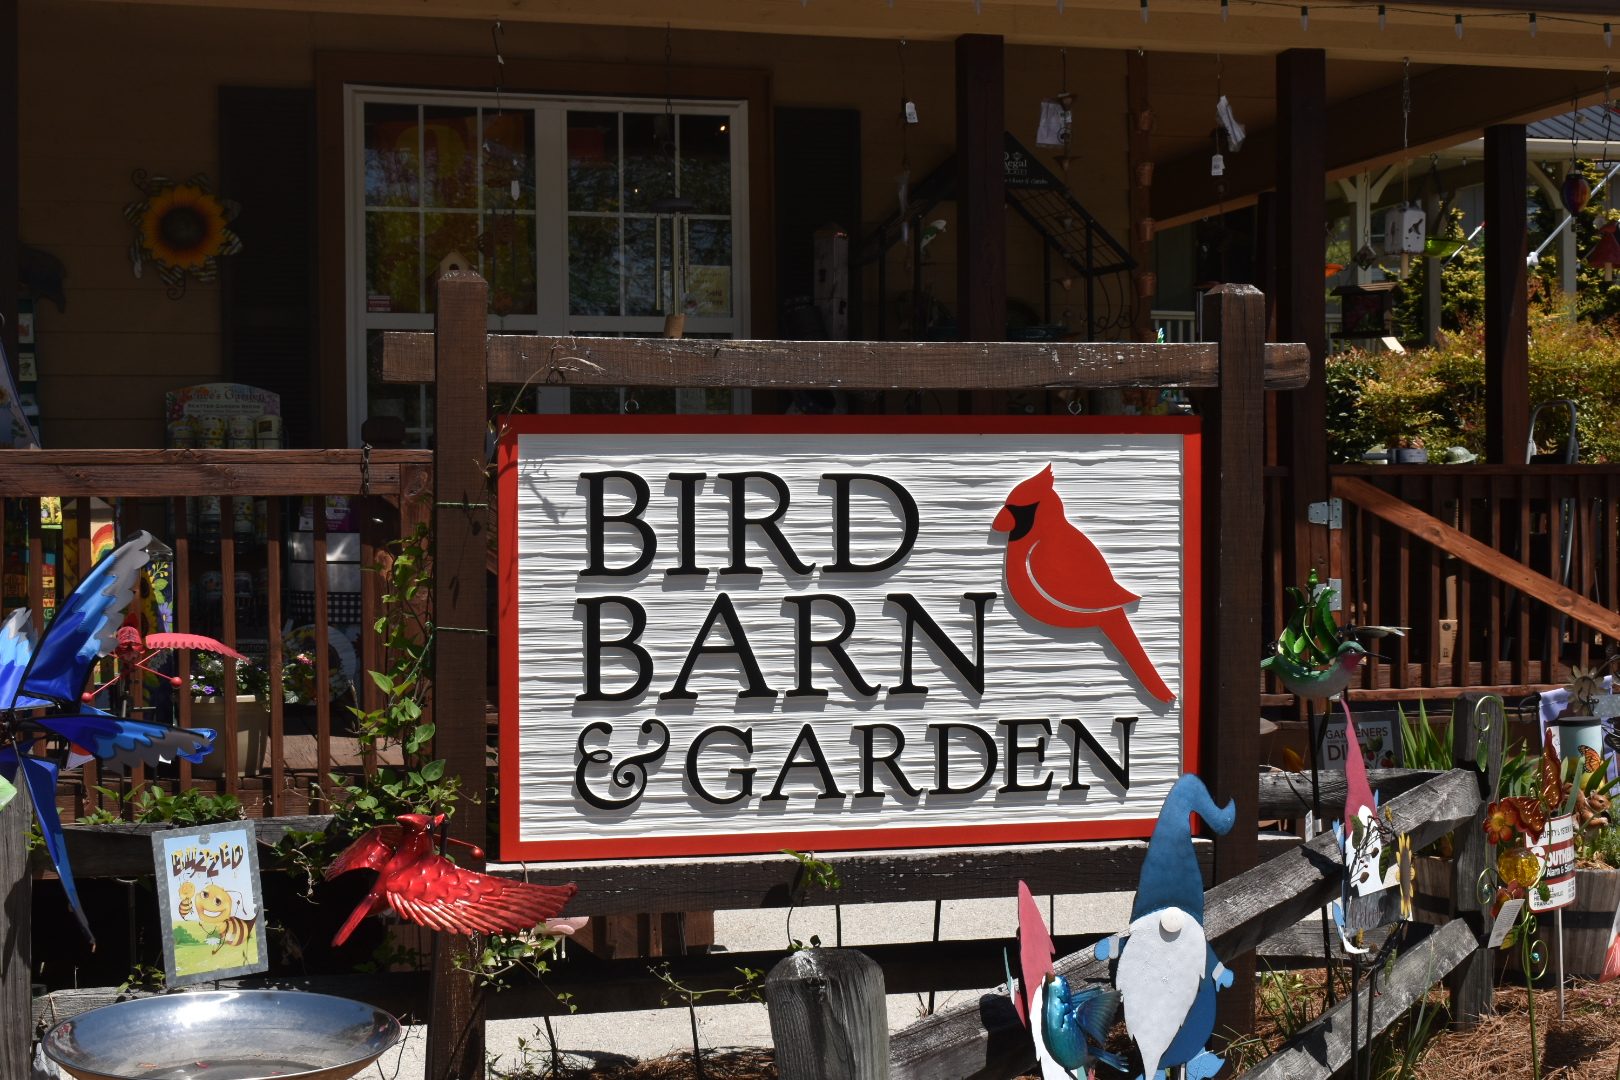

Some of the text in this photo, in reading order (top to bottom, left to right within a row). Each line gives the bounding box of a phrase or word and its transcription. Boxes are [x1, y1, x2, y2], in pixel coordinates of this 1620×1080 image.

[579, 470, 920, 576] BIRD
[575, 592, 997, 701] BARN
[575, 716, 1139, 810] & GARDEN
[1325, 726, 1389, 740] GARENERS
[171, 842, 243, 878] BUZZED
